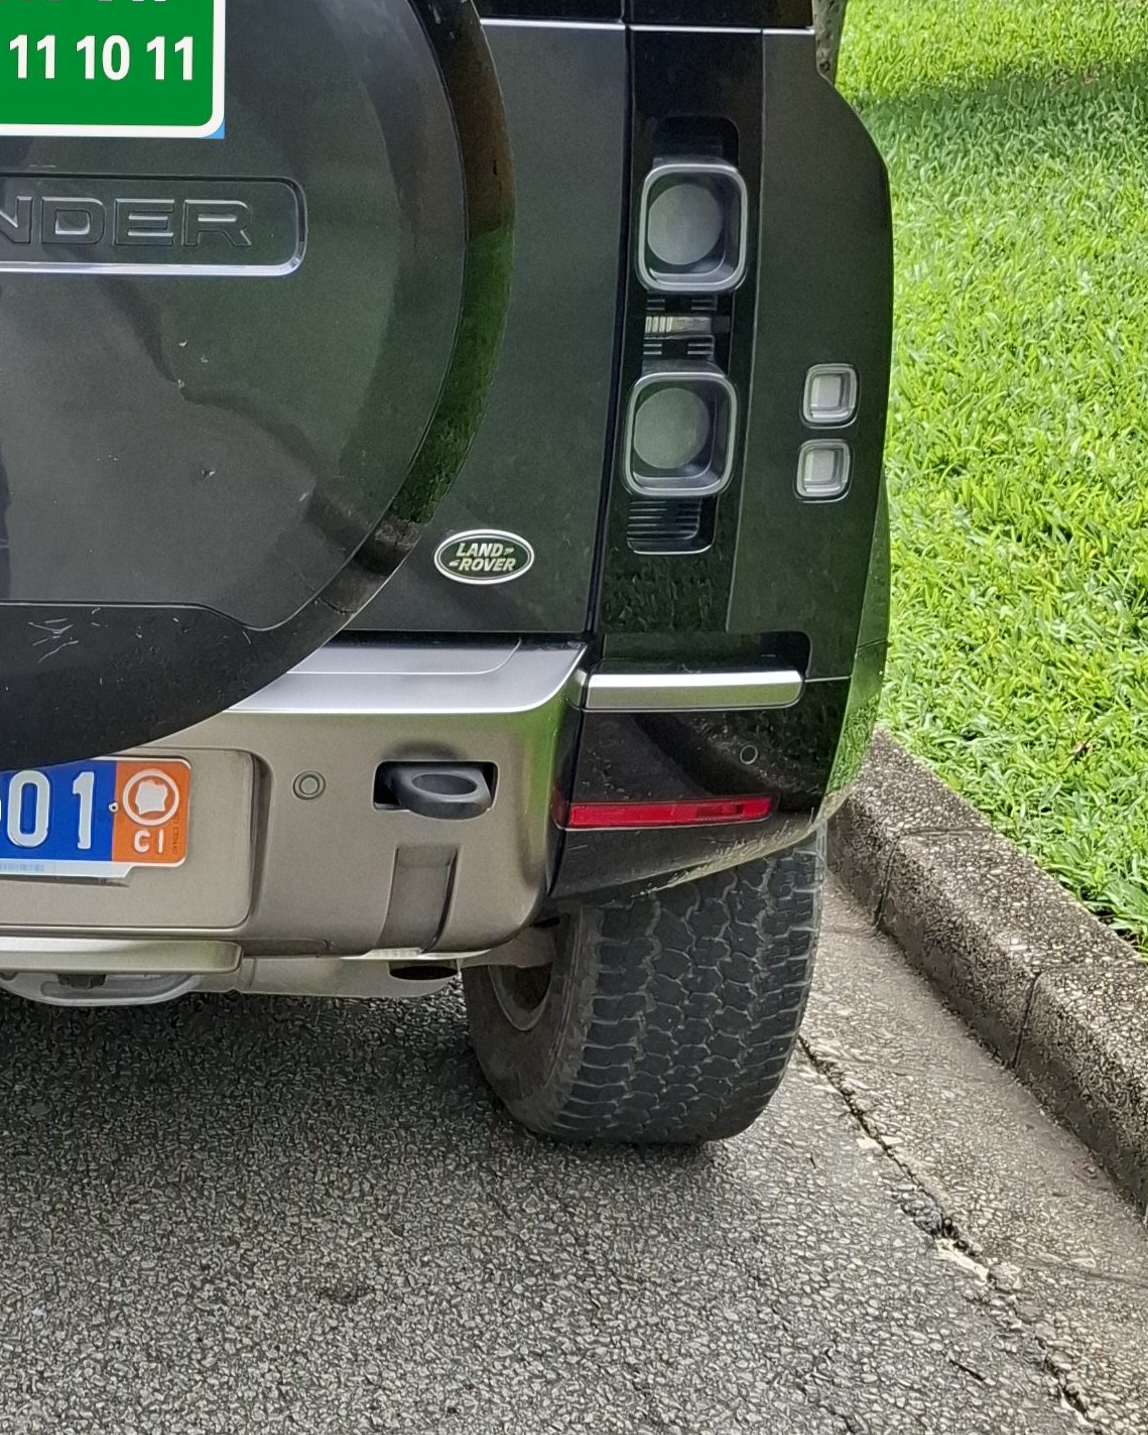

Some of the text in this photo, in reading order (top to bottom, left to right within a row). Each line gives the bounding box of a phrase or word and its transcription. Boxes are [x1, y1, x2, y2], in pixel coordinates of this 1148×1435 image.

[456, 542, 504, 557] LAND
[458, 557, 516, 572] ROVER
[134, 828, 165, 854] CI
